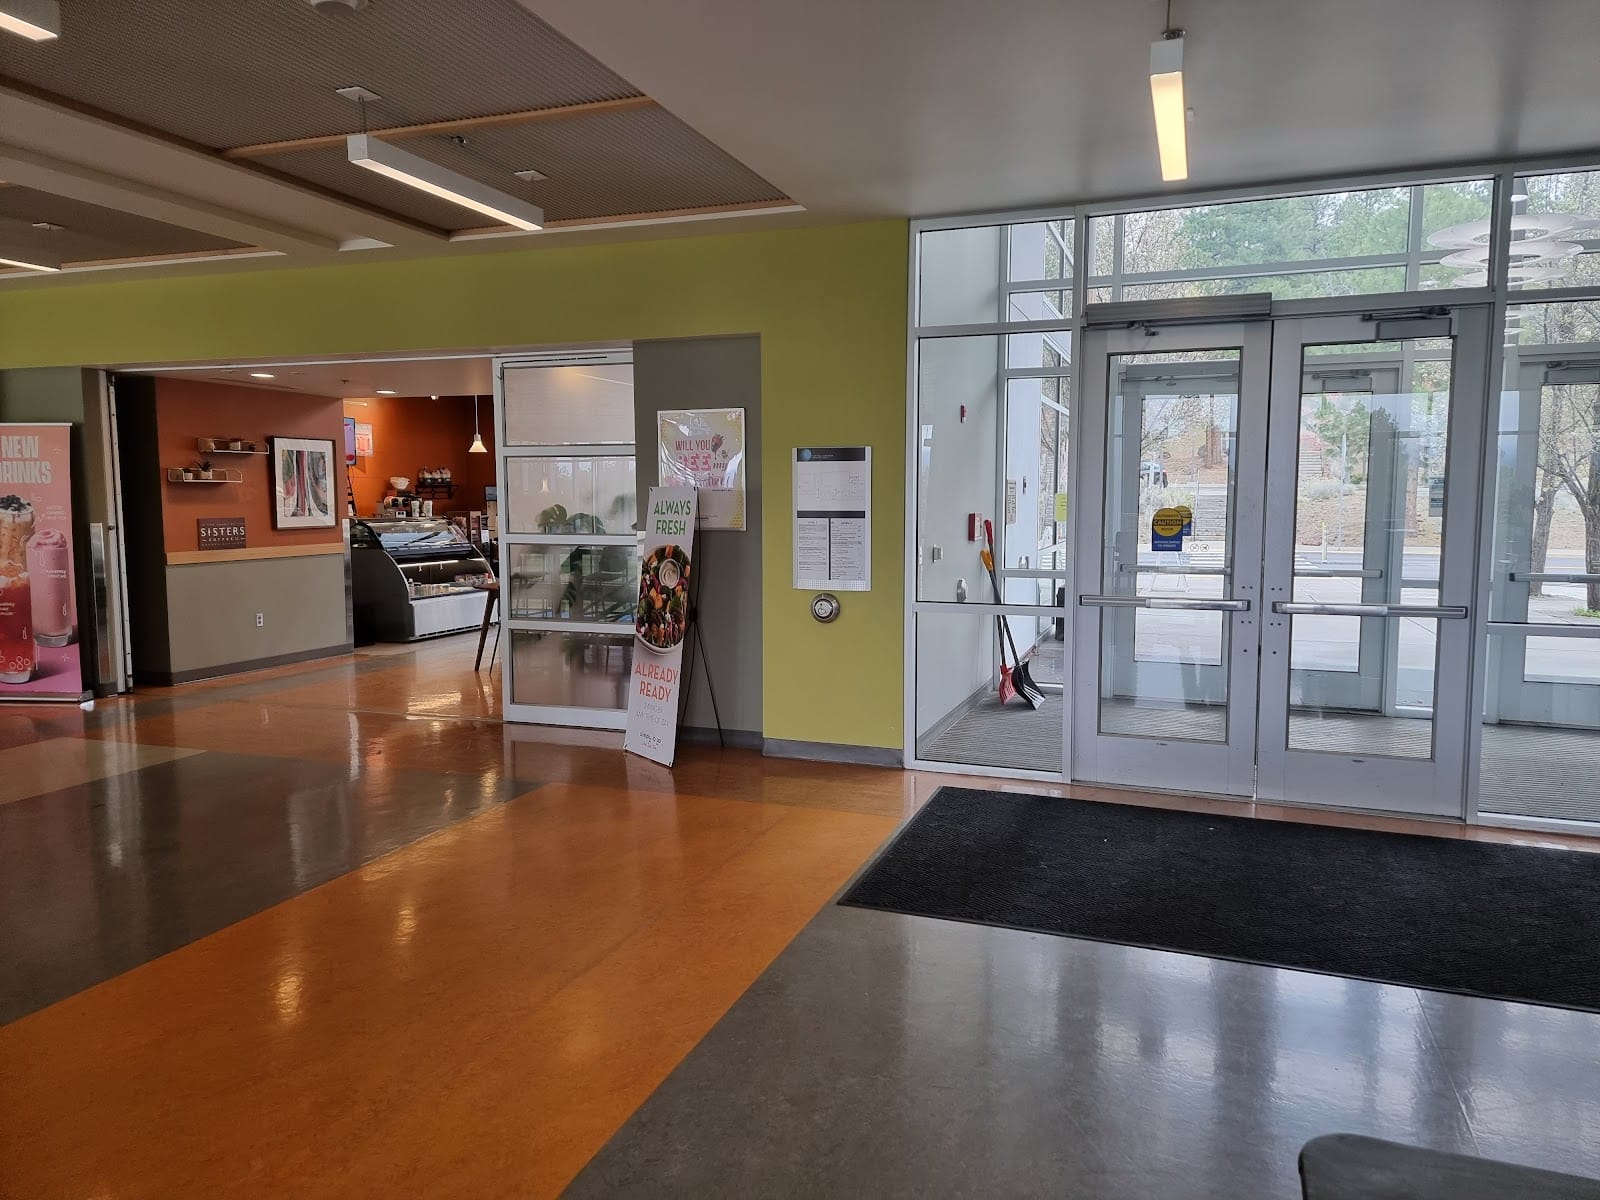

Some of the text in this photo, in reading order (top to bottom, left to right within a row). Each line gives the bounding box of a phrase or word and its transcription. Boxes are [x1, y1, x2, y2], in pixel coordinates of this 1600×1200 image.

[1, 436, 39, 458] NEW
[675, 440, 710, 451] WILL YOU
[653, 500, 691, 516] ALWAYS
[200, 526, 245, 537] SISTERS
[655, 519, 686, 536] FRESH
[635, 662, 678, 684] ALREADY
[639, 681, 672, 702] READY
